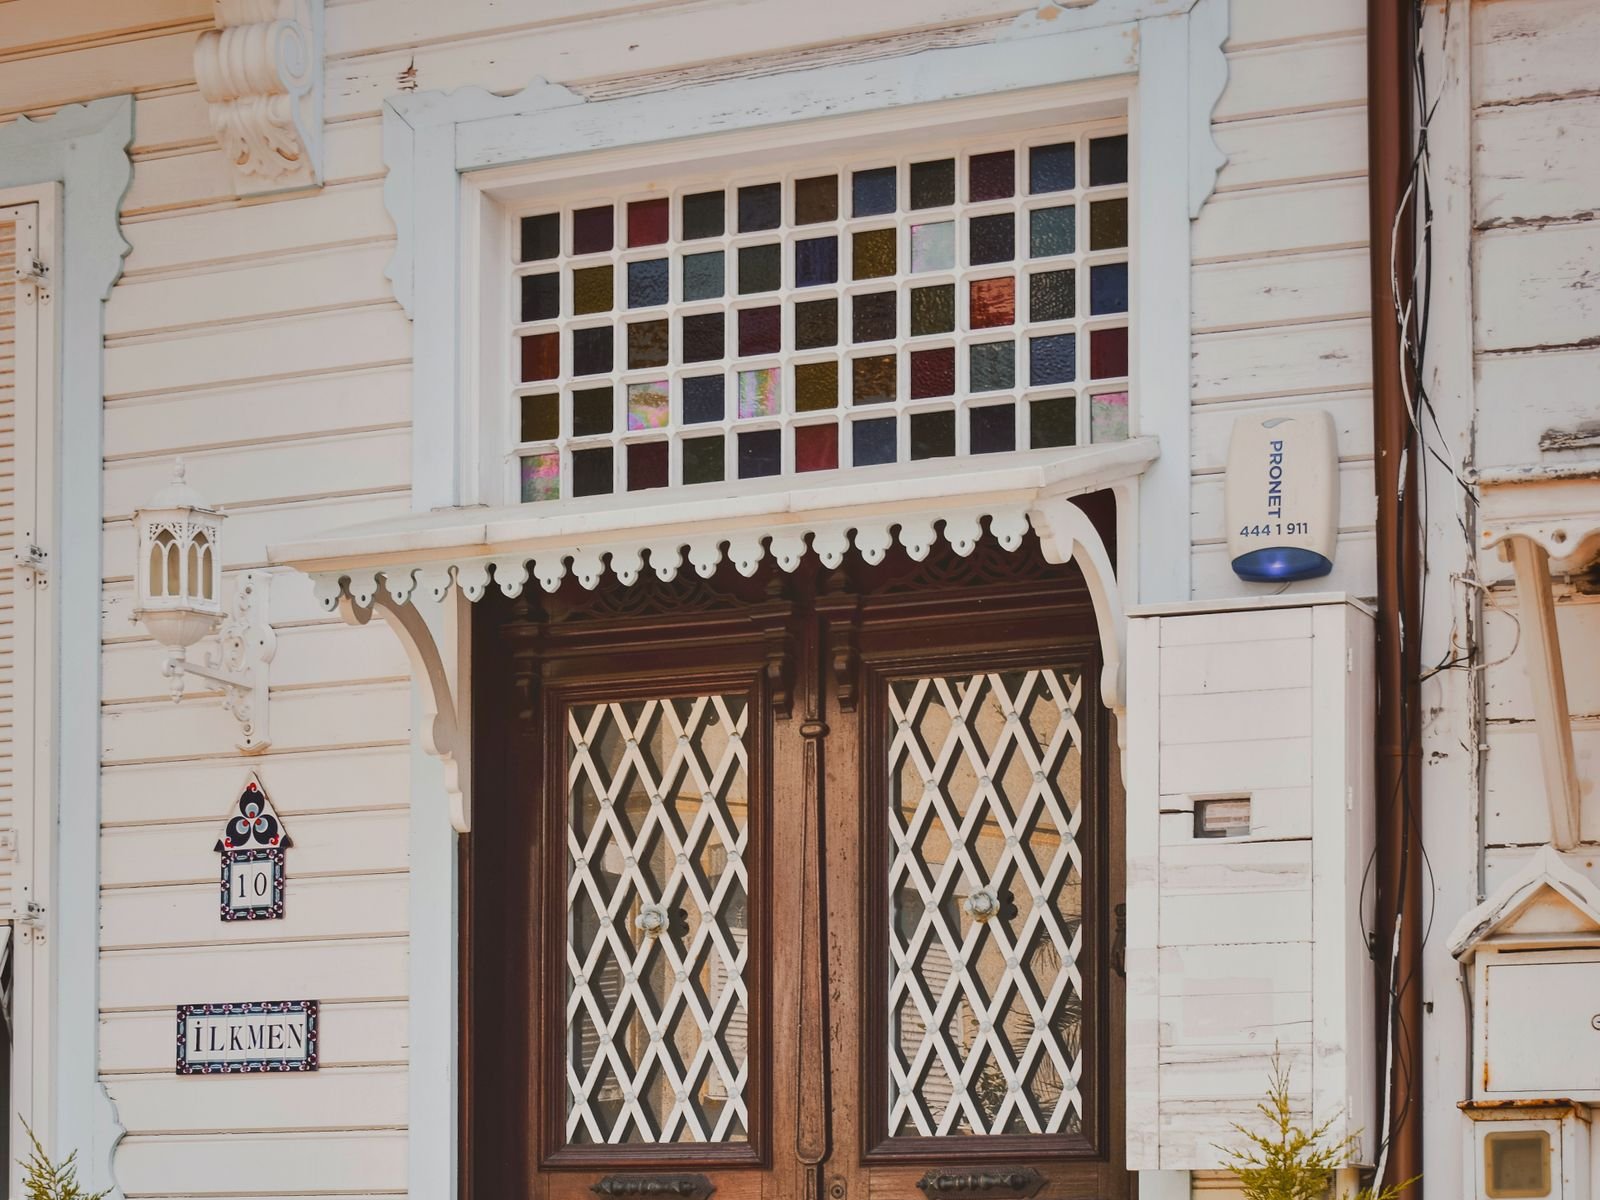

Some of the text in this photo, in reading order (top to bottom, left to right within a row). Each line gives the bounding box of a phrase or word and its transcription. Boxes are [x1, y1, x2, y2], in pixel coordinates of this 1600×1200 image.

[1268, 440, 1283, 518] PRONET
[1240, 524, 1271, 537] 444
[1287, 523, 1308, 535] 911
[238, 872, 267, 898] 10
[194, 1020, 303, 1052] İLKMEN
